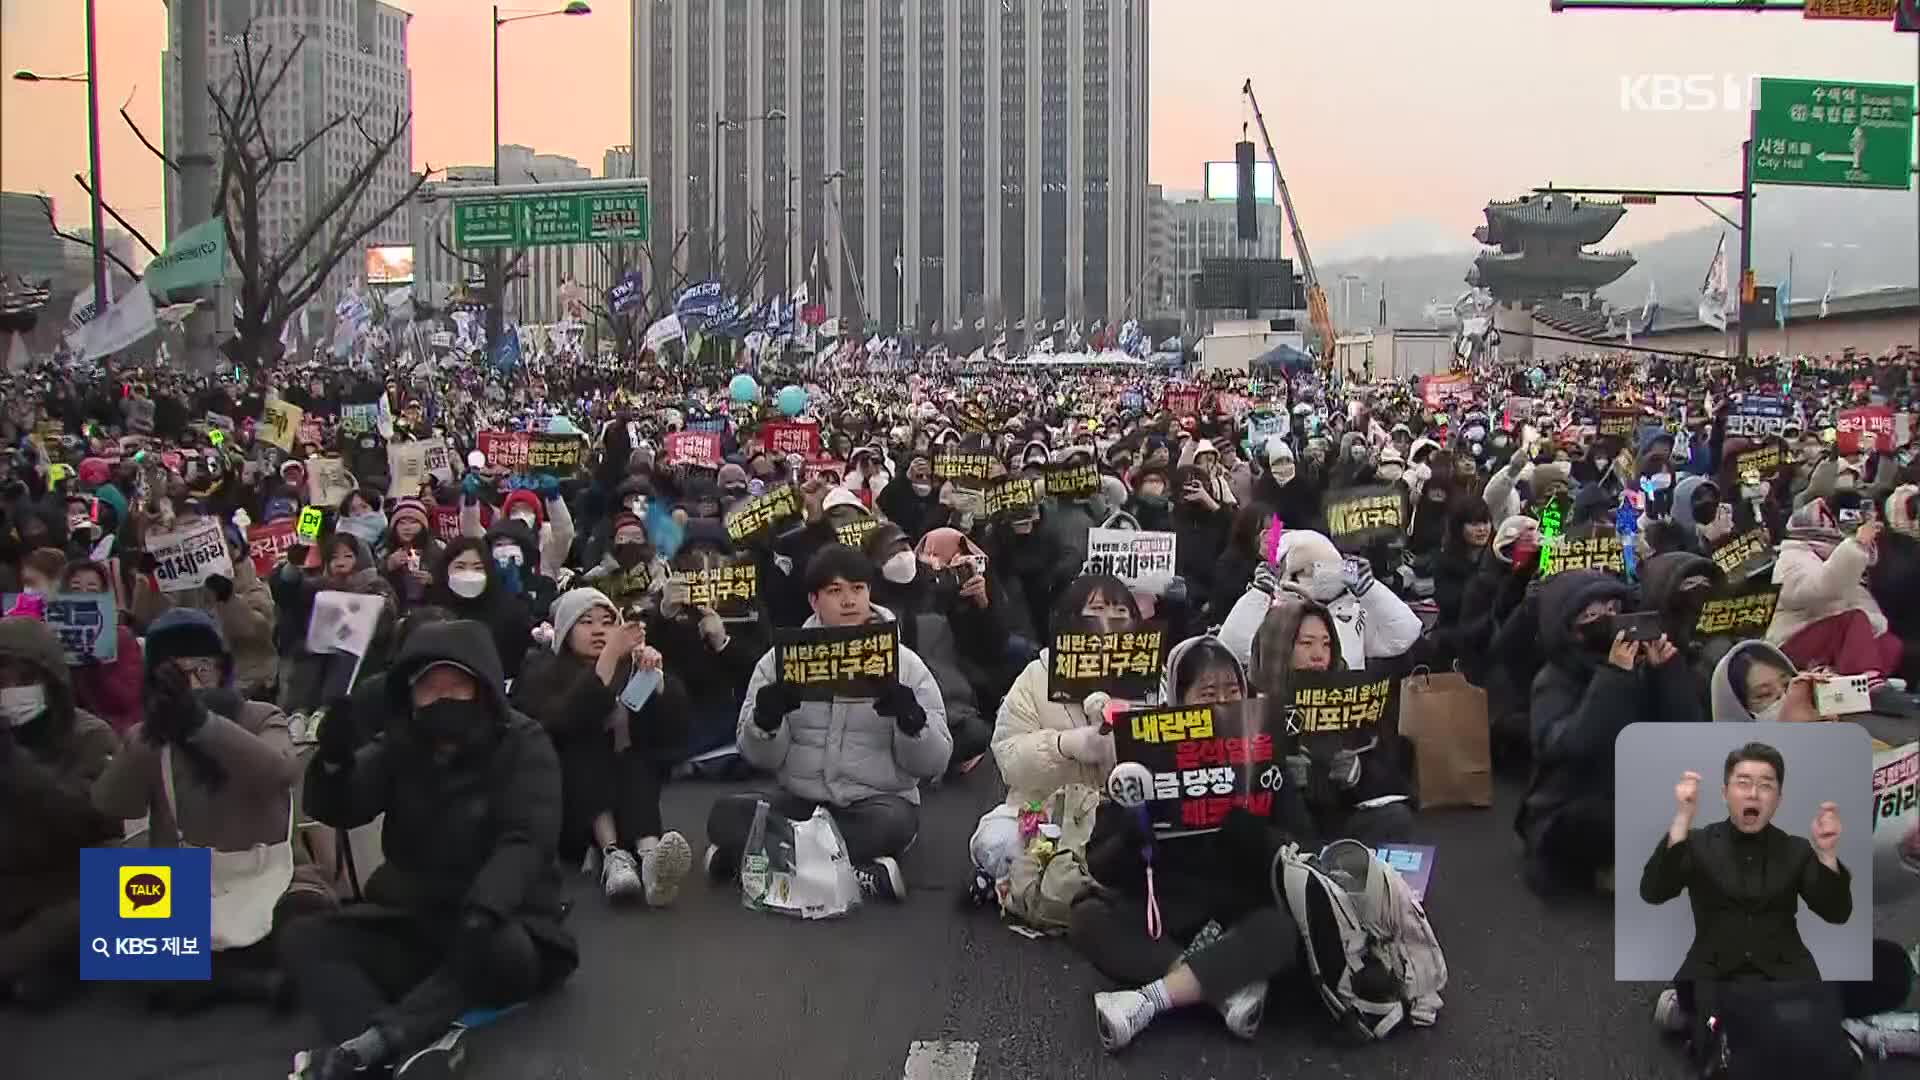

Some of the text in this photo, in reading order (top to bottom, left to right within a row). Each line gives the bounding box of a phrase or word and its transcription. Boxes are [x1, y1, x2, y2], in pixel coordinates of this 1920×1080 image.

[1758, 137, 1786, 155] 시청
[1758, 156, 1803, 171] City Hall
[156, 543, 224, 581] 해체하라
[1091, 553, 1171, 578] 해체하라
[783, 633, 893, 662] 내란수괴 윤석열
[1056, 631, 1161, 653] 내란수괴 윤석열
[783, 650, 894, 684] 체포!구속!
[1055, 650, 1158, 680] 체포!구속!
[1296, 686, 1357, 706] 내란수괴
[1131, 710, 1214, 744] 내란범
[1176, 735, 1273, 769] 윤석열을
[1154, 771, 1180, 800] 금
